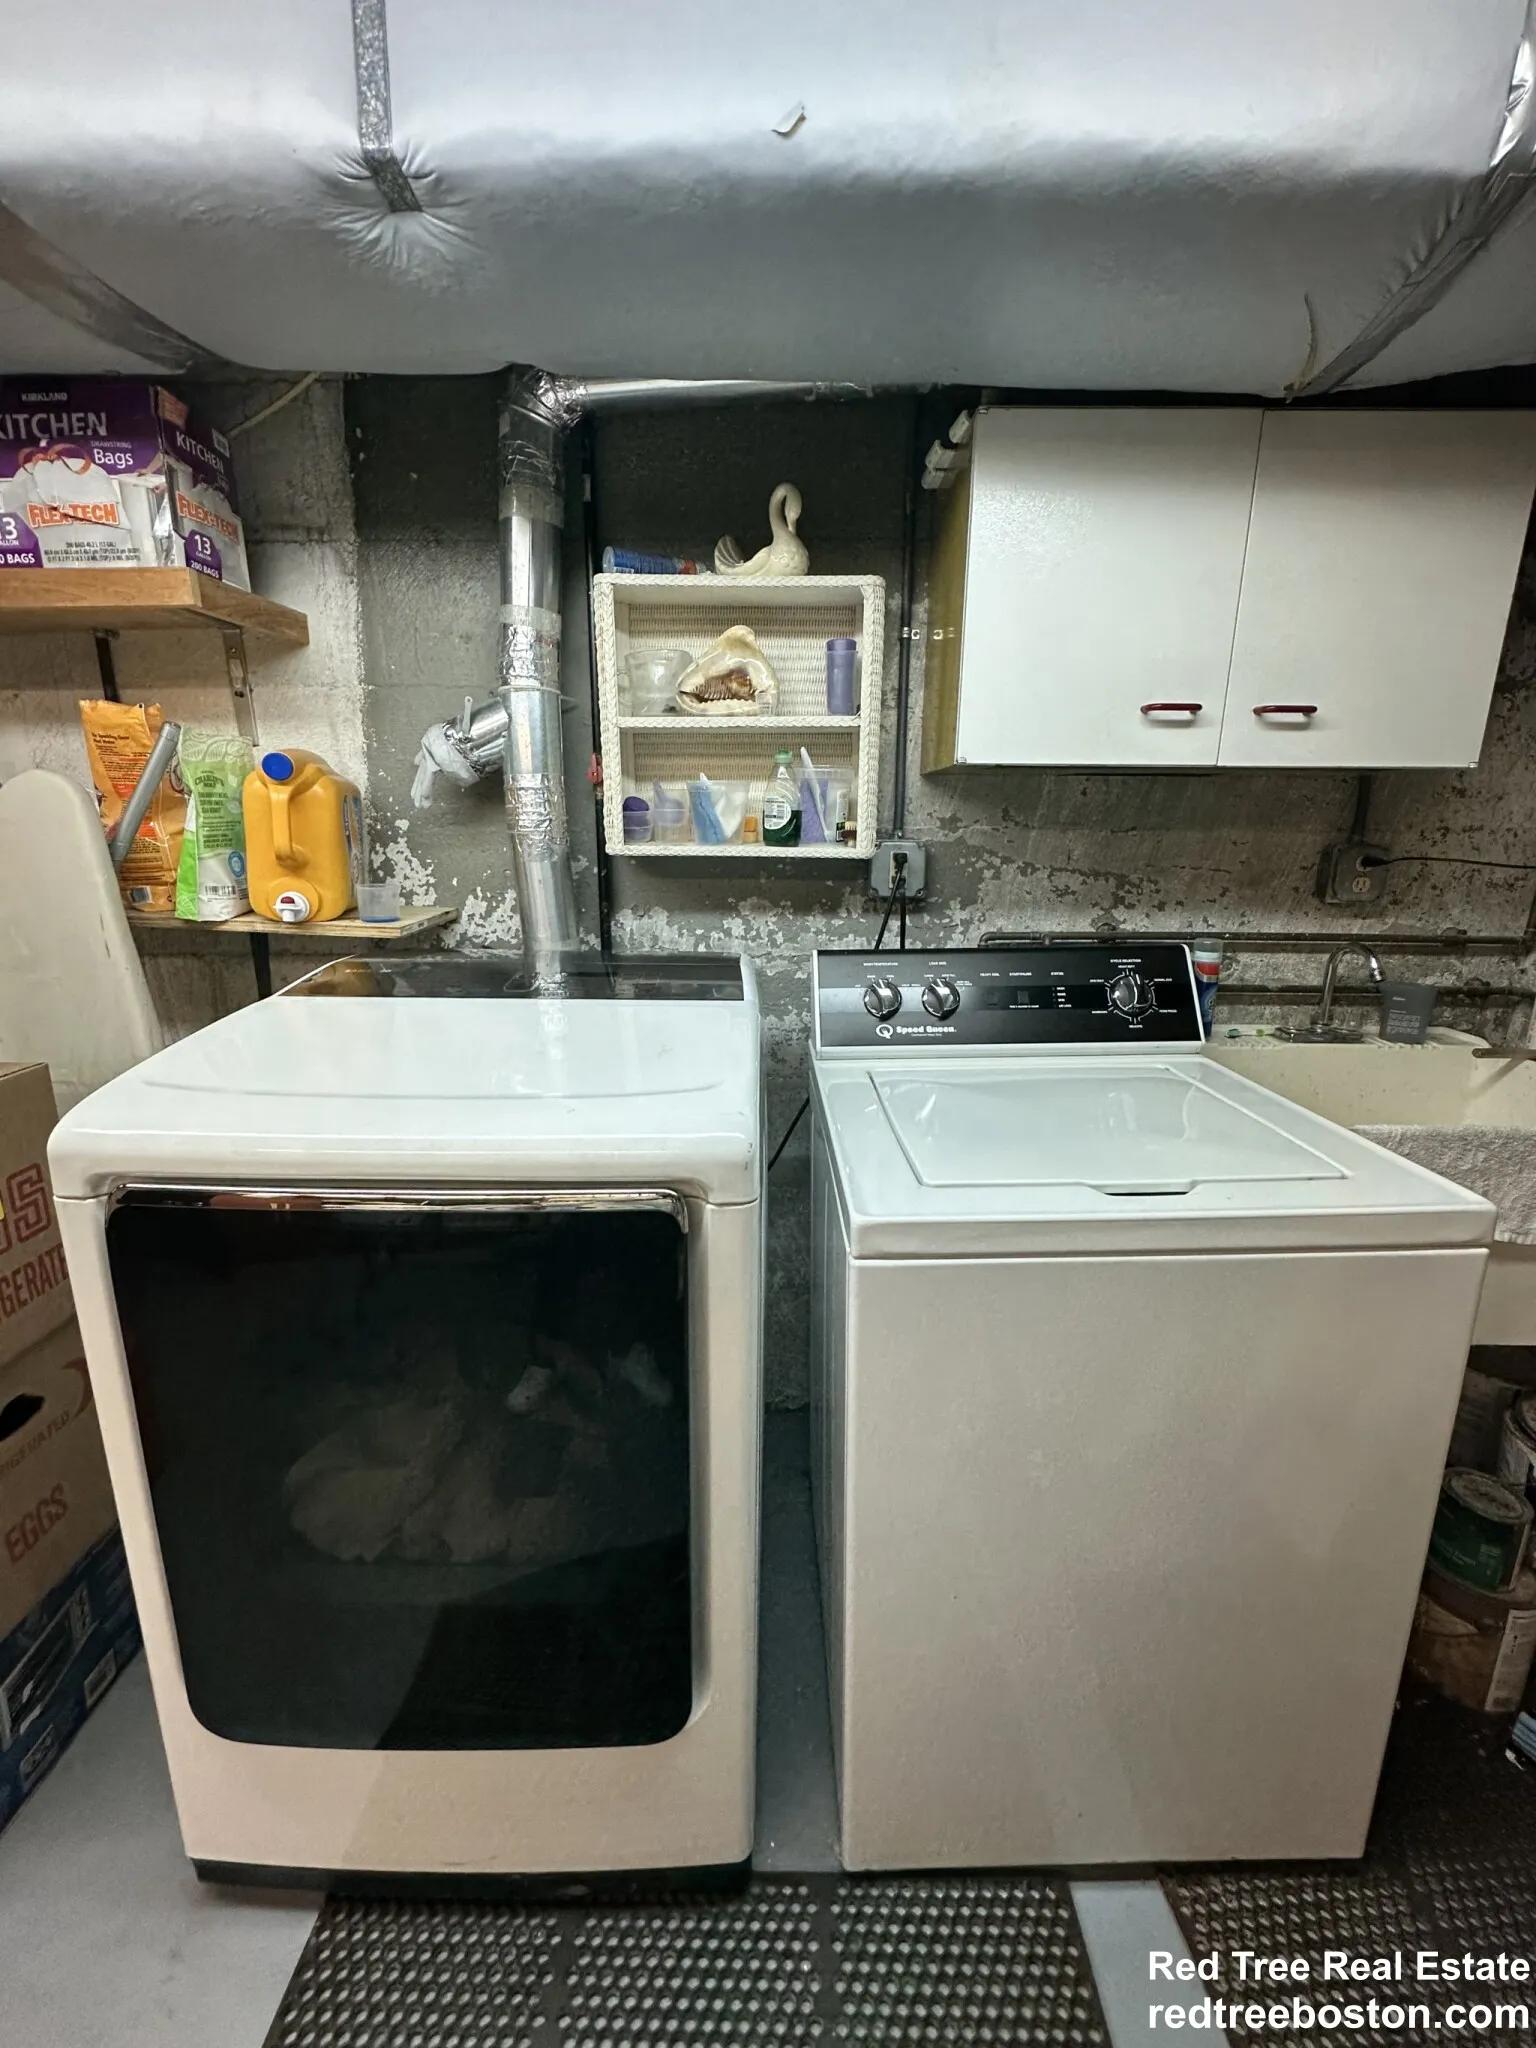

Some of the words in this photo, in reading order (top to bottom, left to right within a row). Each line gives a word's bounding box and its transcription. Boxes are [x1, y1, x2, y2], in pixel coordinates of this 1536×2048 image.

[21, 392, 69, 402] KIRKLAND
[93, 448, 134, 468] Bags
[176, 430, 225, 475] KITCHEN
[194, 534, 212, 555] 13
[7, 553, 35, 564] BAGS
[203, 565, 220, 579] BAGS
[896, 1025, 925, 1035] Speed
[5, 1482, 69, 1567] EGGS
